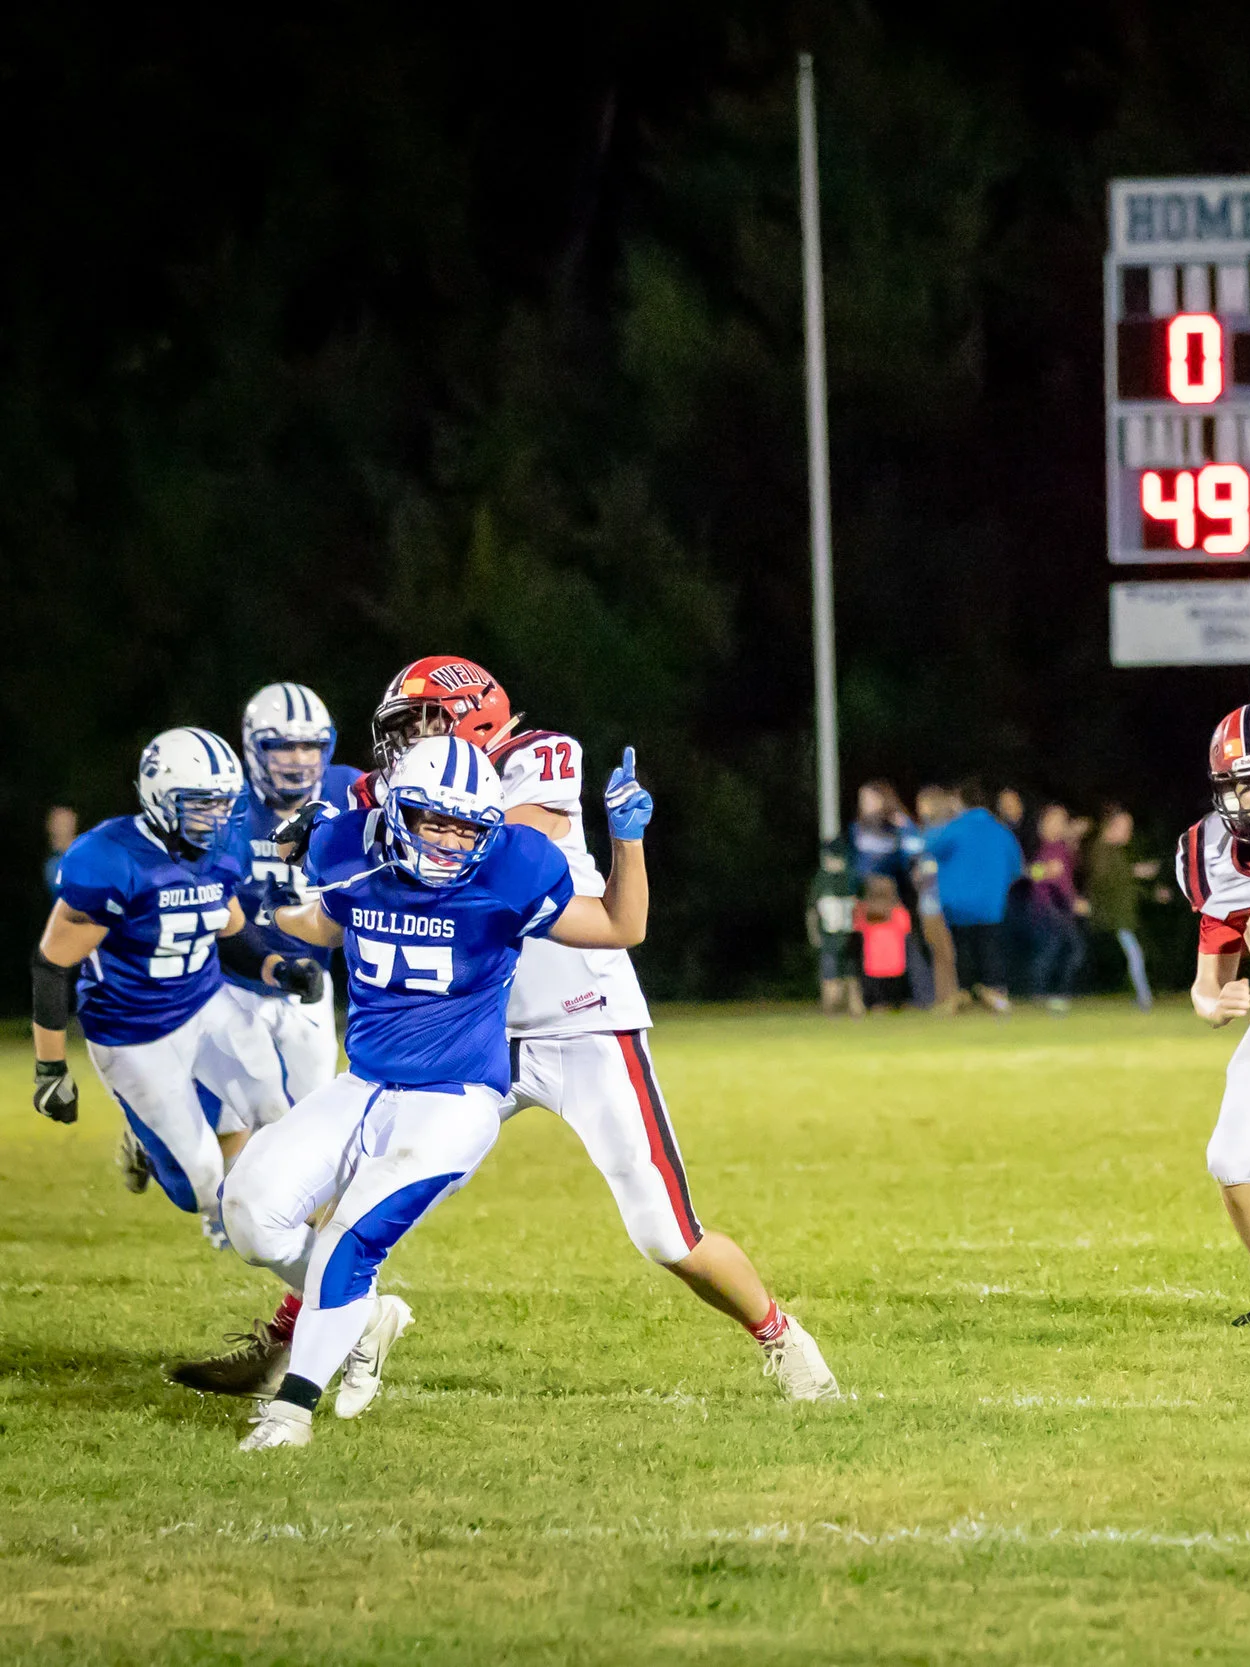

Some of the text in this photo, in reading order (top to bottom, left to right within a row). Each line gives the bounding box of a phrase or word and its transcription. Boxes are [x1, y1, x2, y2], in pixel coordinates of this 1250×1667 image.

[1167, 312, 1223, 404] 0
[1141, 462, 1250, 554] 49
[429, 663, 498, 693] WELL
[534, 741, 575, 782] 72
[158, 882, 225, 909] BULLDOGS
[351, 906, 456, 939] BULLDOGS
